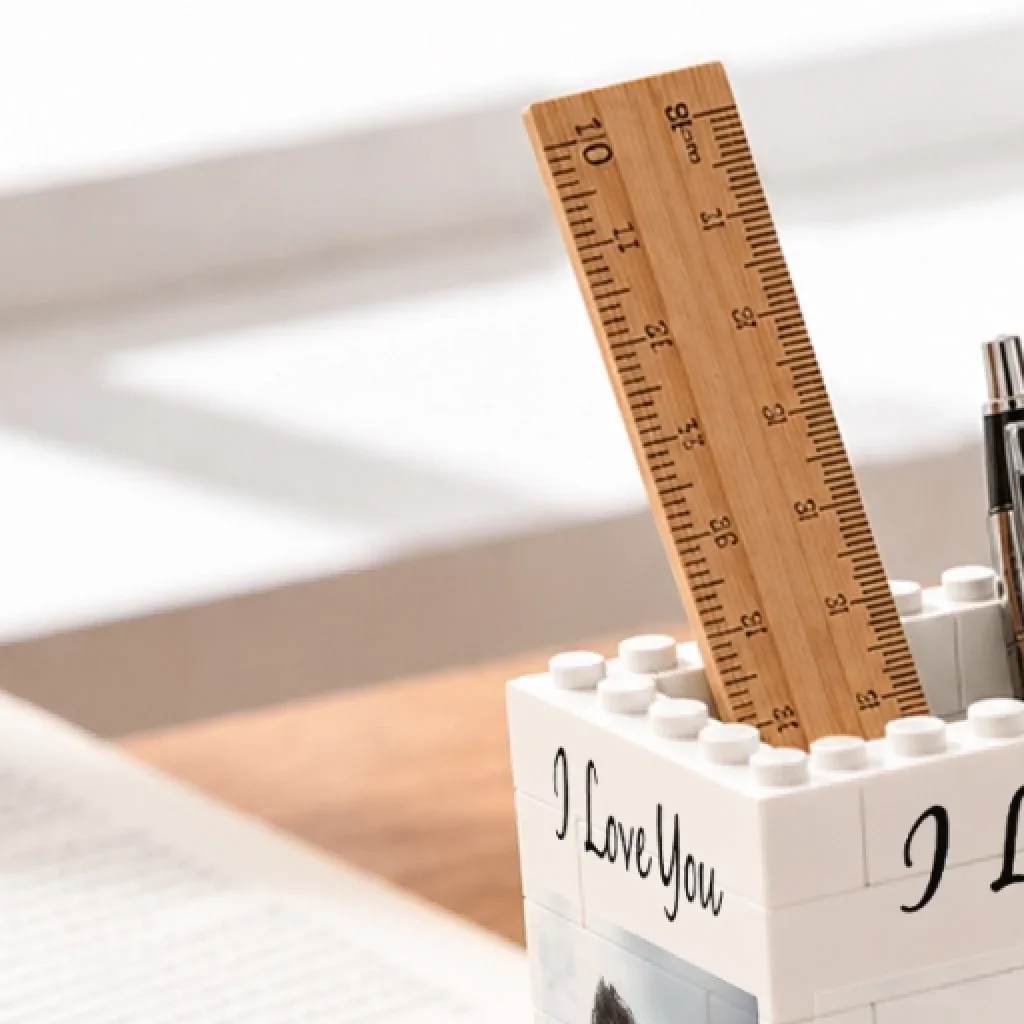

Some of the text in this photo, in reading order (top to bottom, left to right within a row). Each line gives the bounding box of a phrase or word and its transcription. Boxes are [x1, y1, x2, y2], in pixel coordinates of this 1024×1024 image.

[553, 746, 723, 924] I Love You
[899, 804, 951, 914] I
